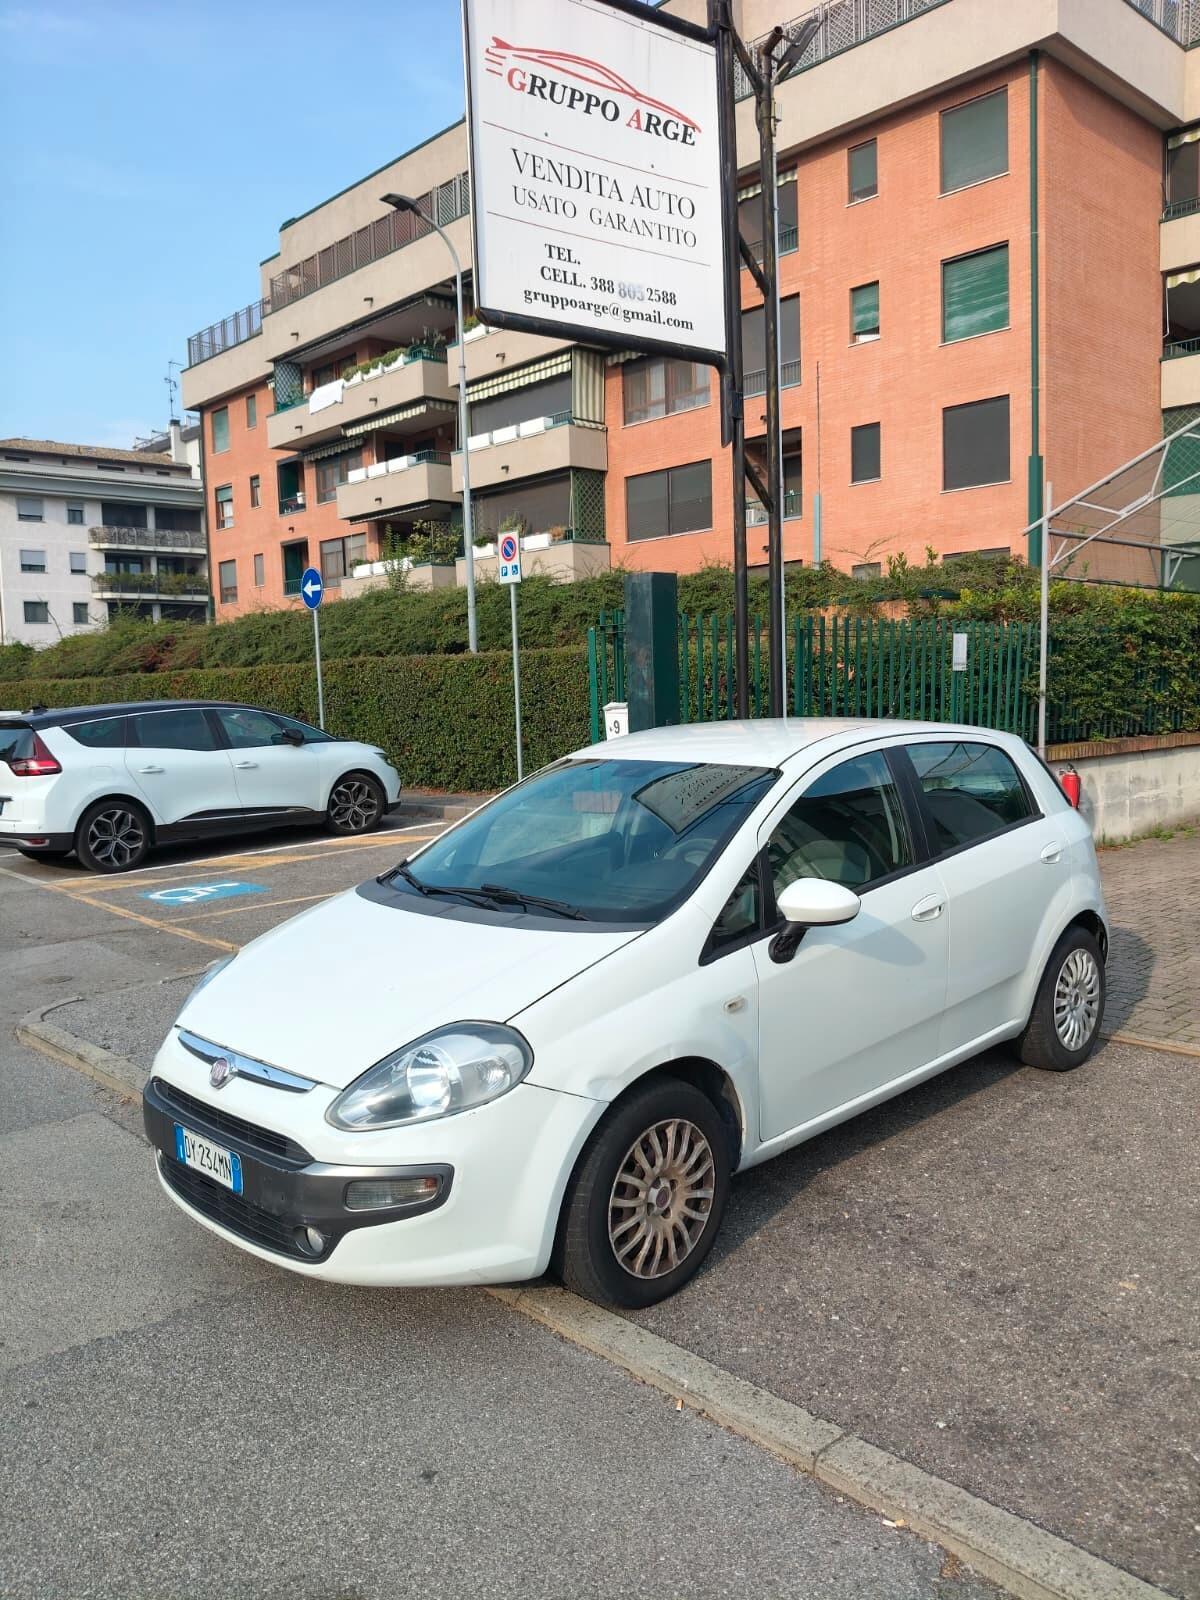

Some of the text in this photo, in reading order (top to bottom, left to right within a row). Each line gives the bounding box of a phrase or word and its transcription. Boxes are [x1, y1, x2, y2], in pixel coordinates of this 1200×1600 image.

[507, 67, 696, 146] GRUPPO ARGE
[511, 148, 696, 219] VENDITA AUTO
[512, 185, 697, 248] USATO GARANTITO
[544, 243, 581, 265] TEL.
[540, 265, 586, 289] CELL.
[590, 276, 615, 295] 388
[646, 287, 677, 306] 2588
[523, 289, 695, 331] gruppoarge@gmail.com
[613, 719, 620, 734] 9
